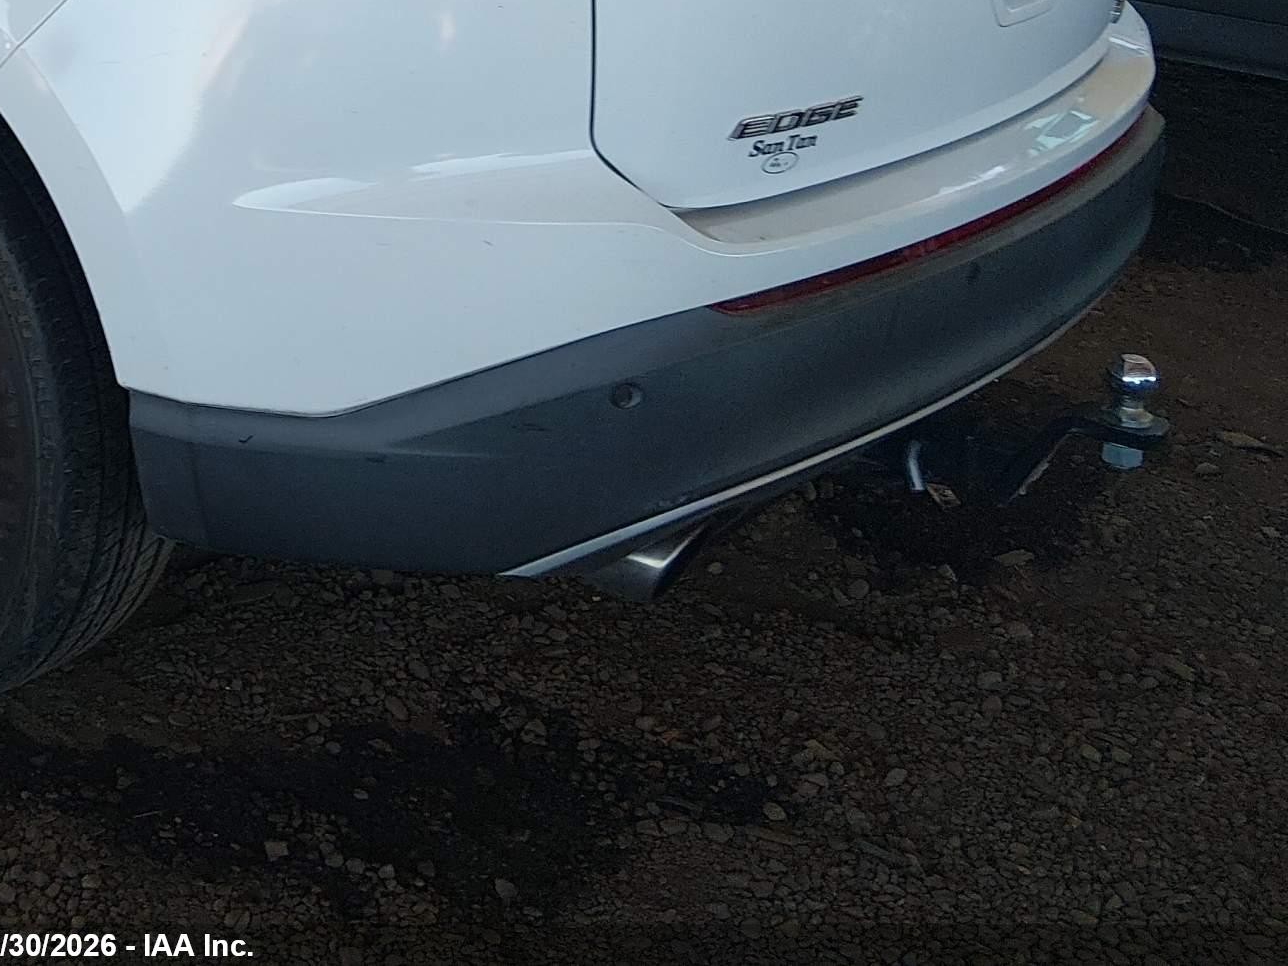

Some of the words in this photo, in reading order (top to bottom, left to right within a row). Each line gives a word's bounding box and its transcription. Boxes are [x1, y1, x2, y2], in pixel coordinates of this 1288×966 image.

[727, 95, 864, 141] EDGE
[748, 139, 785, 157] San
[788, 134, 818, 151] Tan
